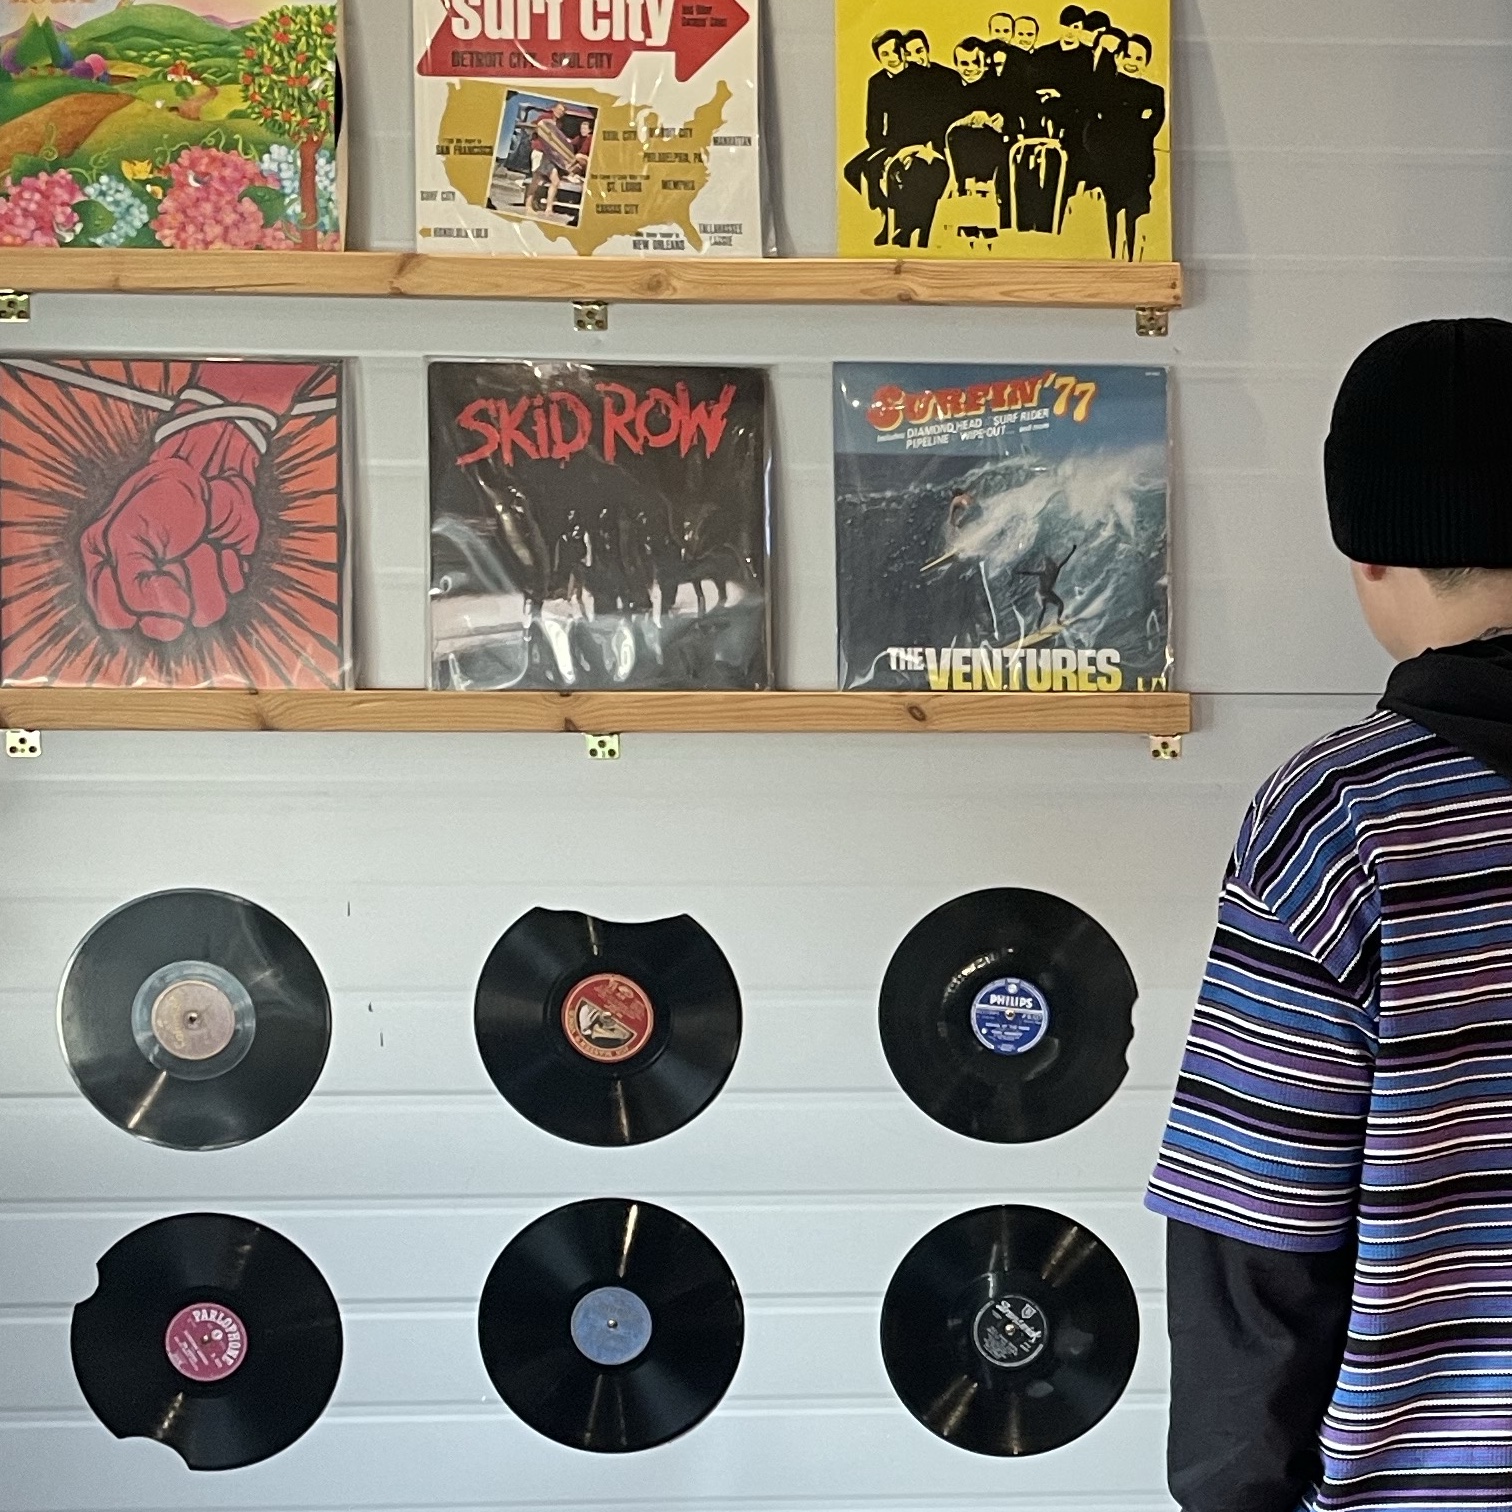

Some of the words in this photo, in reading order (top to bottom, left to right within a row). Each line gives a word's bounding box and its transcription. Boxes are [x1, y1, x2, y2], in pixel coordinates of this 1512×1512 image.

[596, 382, 736, 466] ROW
[906, 423, 953, 439] DIAMOND
[956, 419, 982, 432] HEAD
[993, 412, 1019, 426] SURF
[1019, 410, 1049, 422] RIDER
[906, 434, 950, 449] PIPELINE
[887, 646, 927, 670] THE
[924, 648, 1122, 692] VENTURES
[990, 994, 1033, 1009] PHILIPS
[192, 1309, 241, 1366] PARLOPHONE
